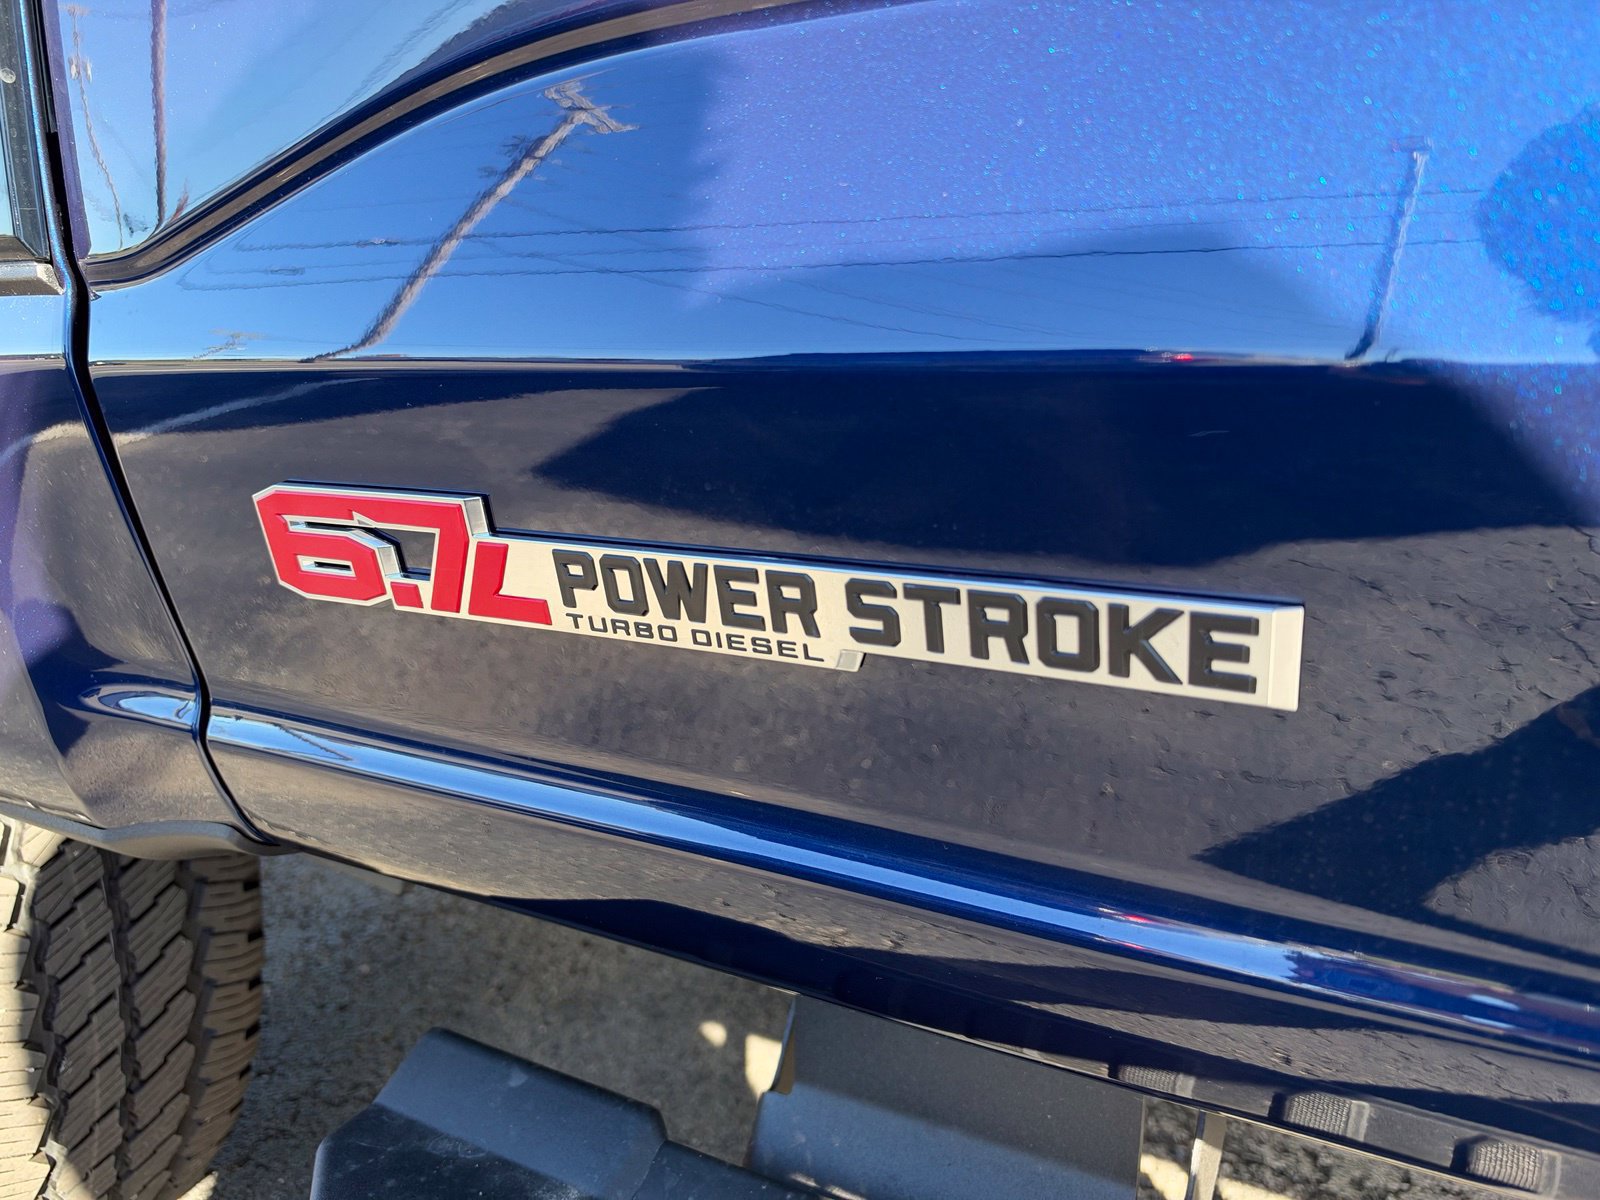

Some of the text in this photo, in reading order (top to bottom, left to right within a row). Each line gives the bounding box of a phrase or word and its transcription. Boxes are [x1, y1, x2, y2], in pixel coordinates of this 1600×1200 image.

[254, 488, 1259, 695] 6.7L POWER STROKE
[565, 612, 825, 663] TURBO DIESEL
